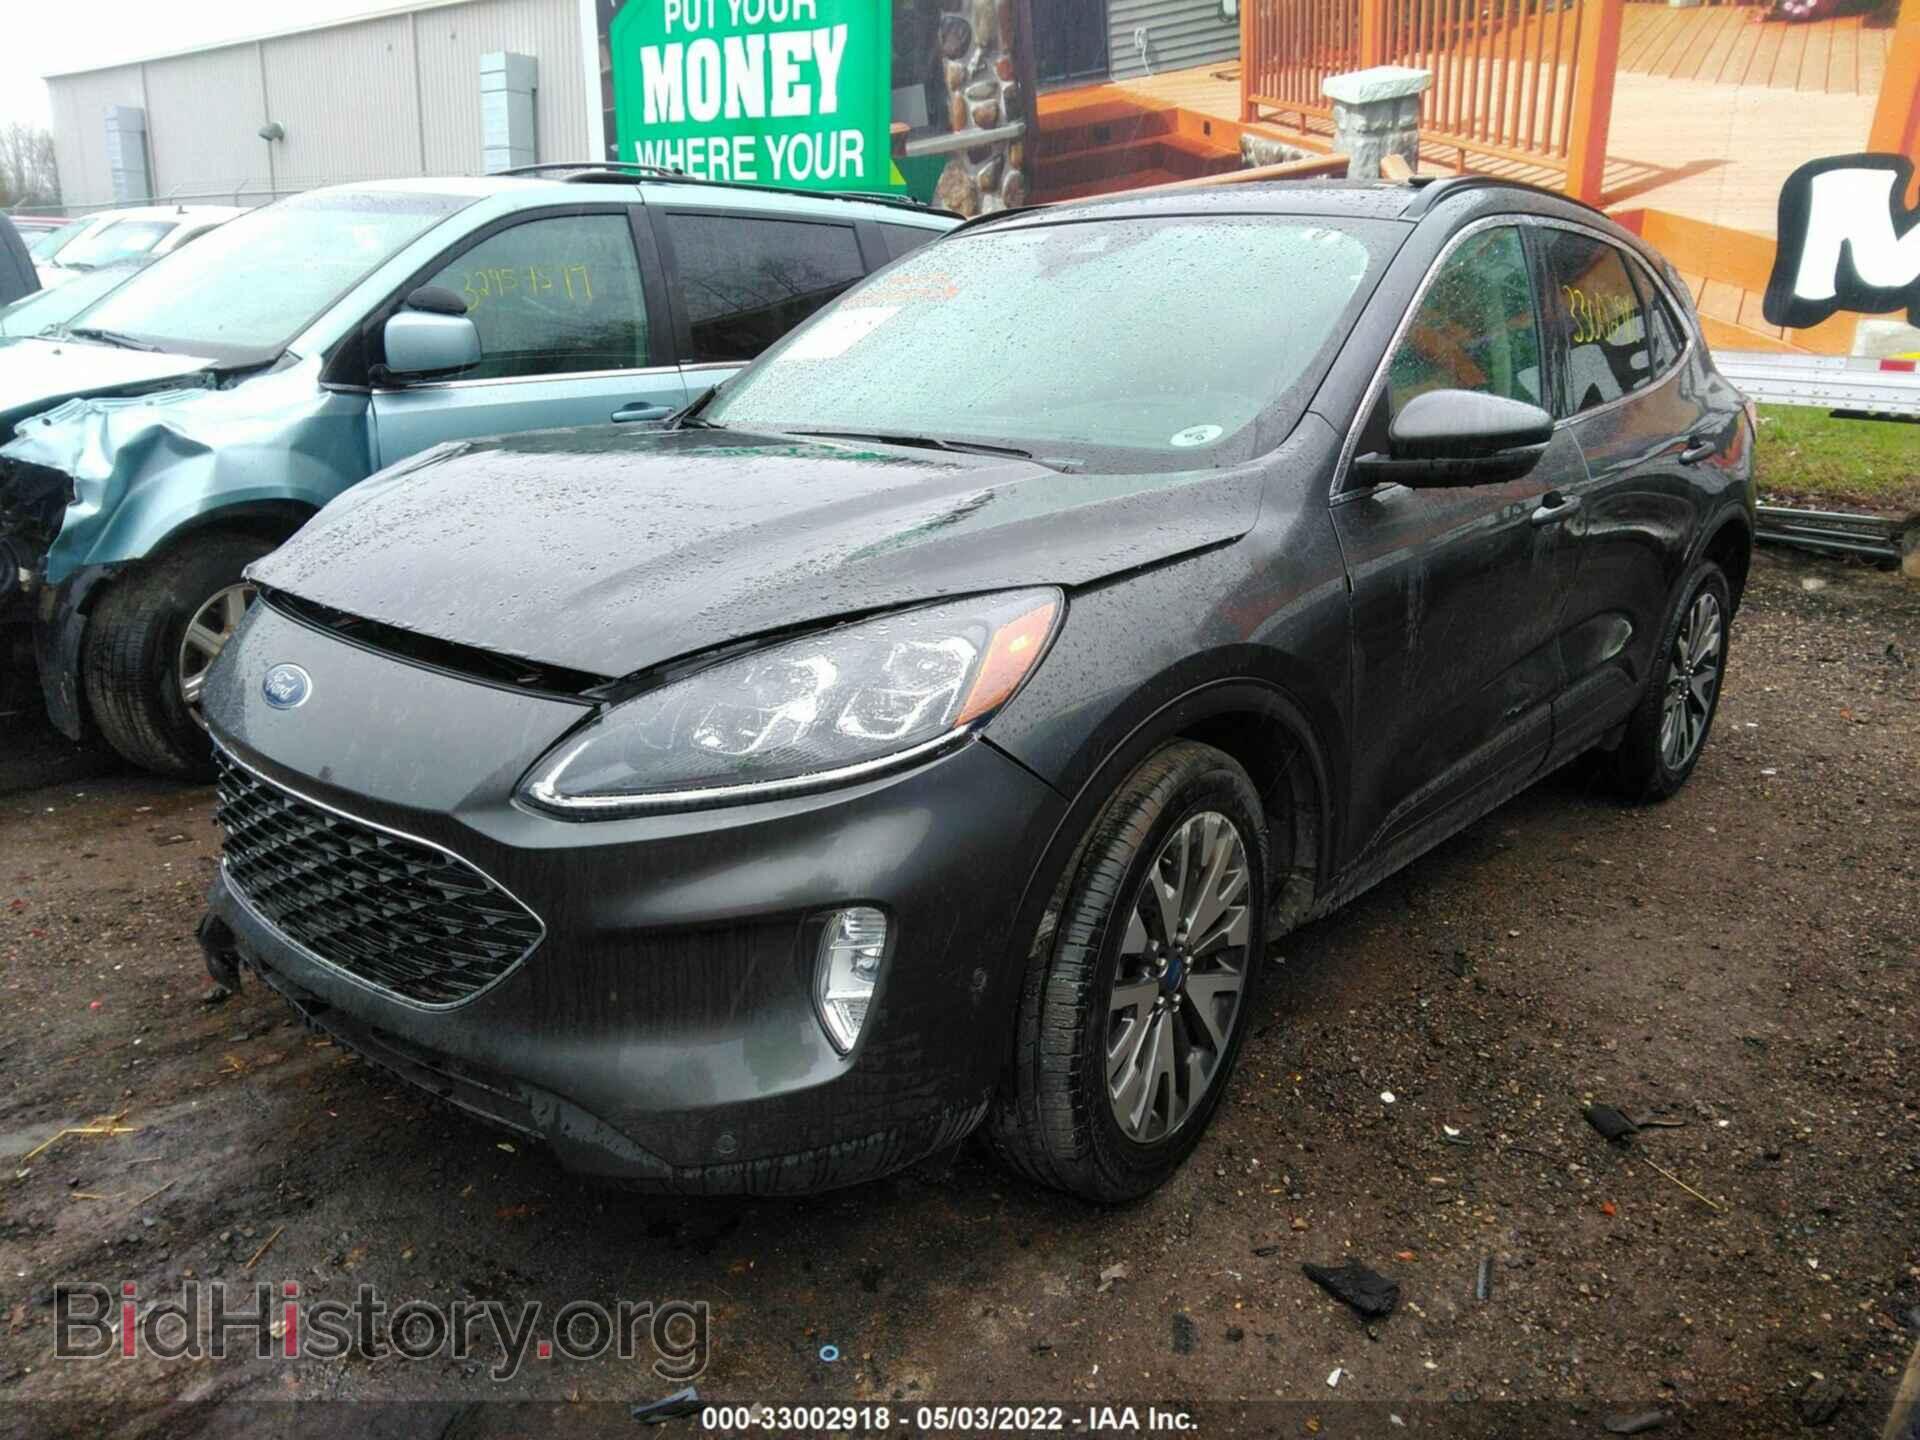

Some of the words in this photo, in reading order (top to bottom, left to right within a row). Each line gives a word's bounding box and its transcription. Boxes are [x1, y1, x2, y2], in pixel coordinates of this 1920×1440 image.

[664, 0, 715, 34] PUT
[640, 24, 848, 125] MONEY
[635, 136, 758, 181] WHERE
[764, 129, 865, 181] YOUR
